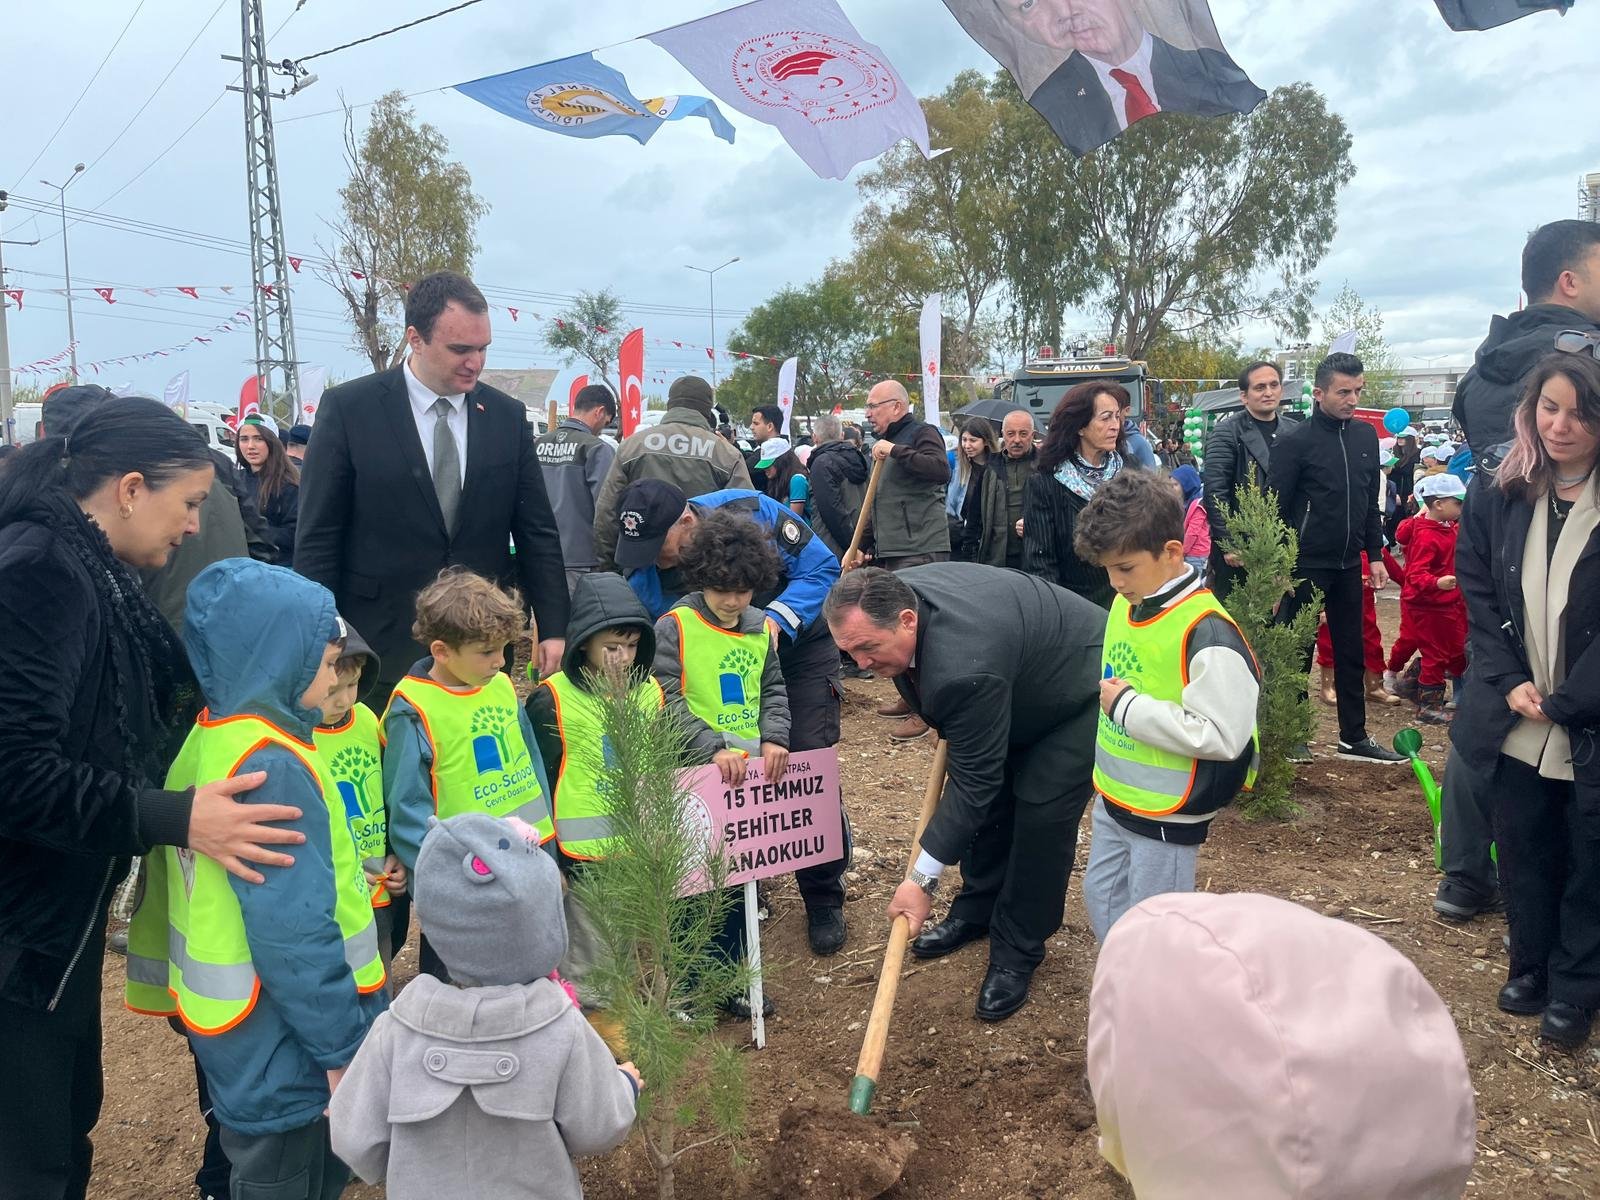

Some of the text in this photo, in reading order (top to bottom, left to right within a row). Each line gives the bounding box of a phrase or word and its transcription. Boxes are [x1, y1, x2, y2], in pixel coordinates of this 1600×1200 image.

[1053, 364, 1101, 372] ANTALYA
[643, 432, 716, 459] OGM
[717, 708, 757, 725] Eco-Sc
[723, 775, 825, 810] 15 TEMMUZ
[724, 807, 814, 848] ŞEHİTLER
[727, 835, 826, 875] ANAOKULU
